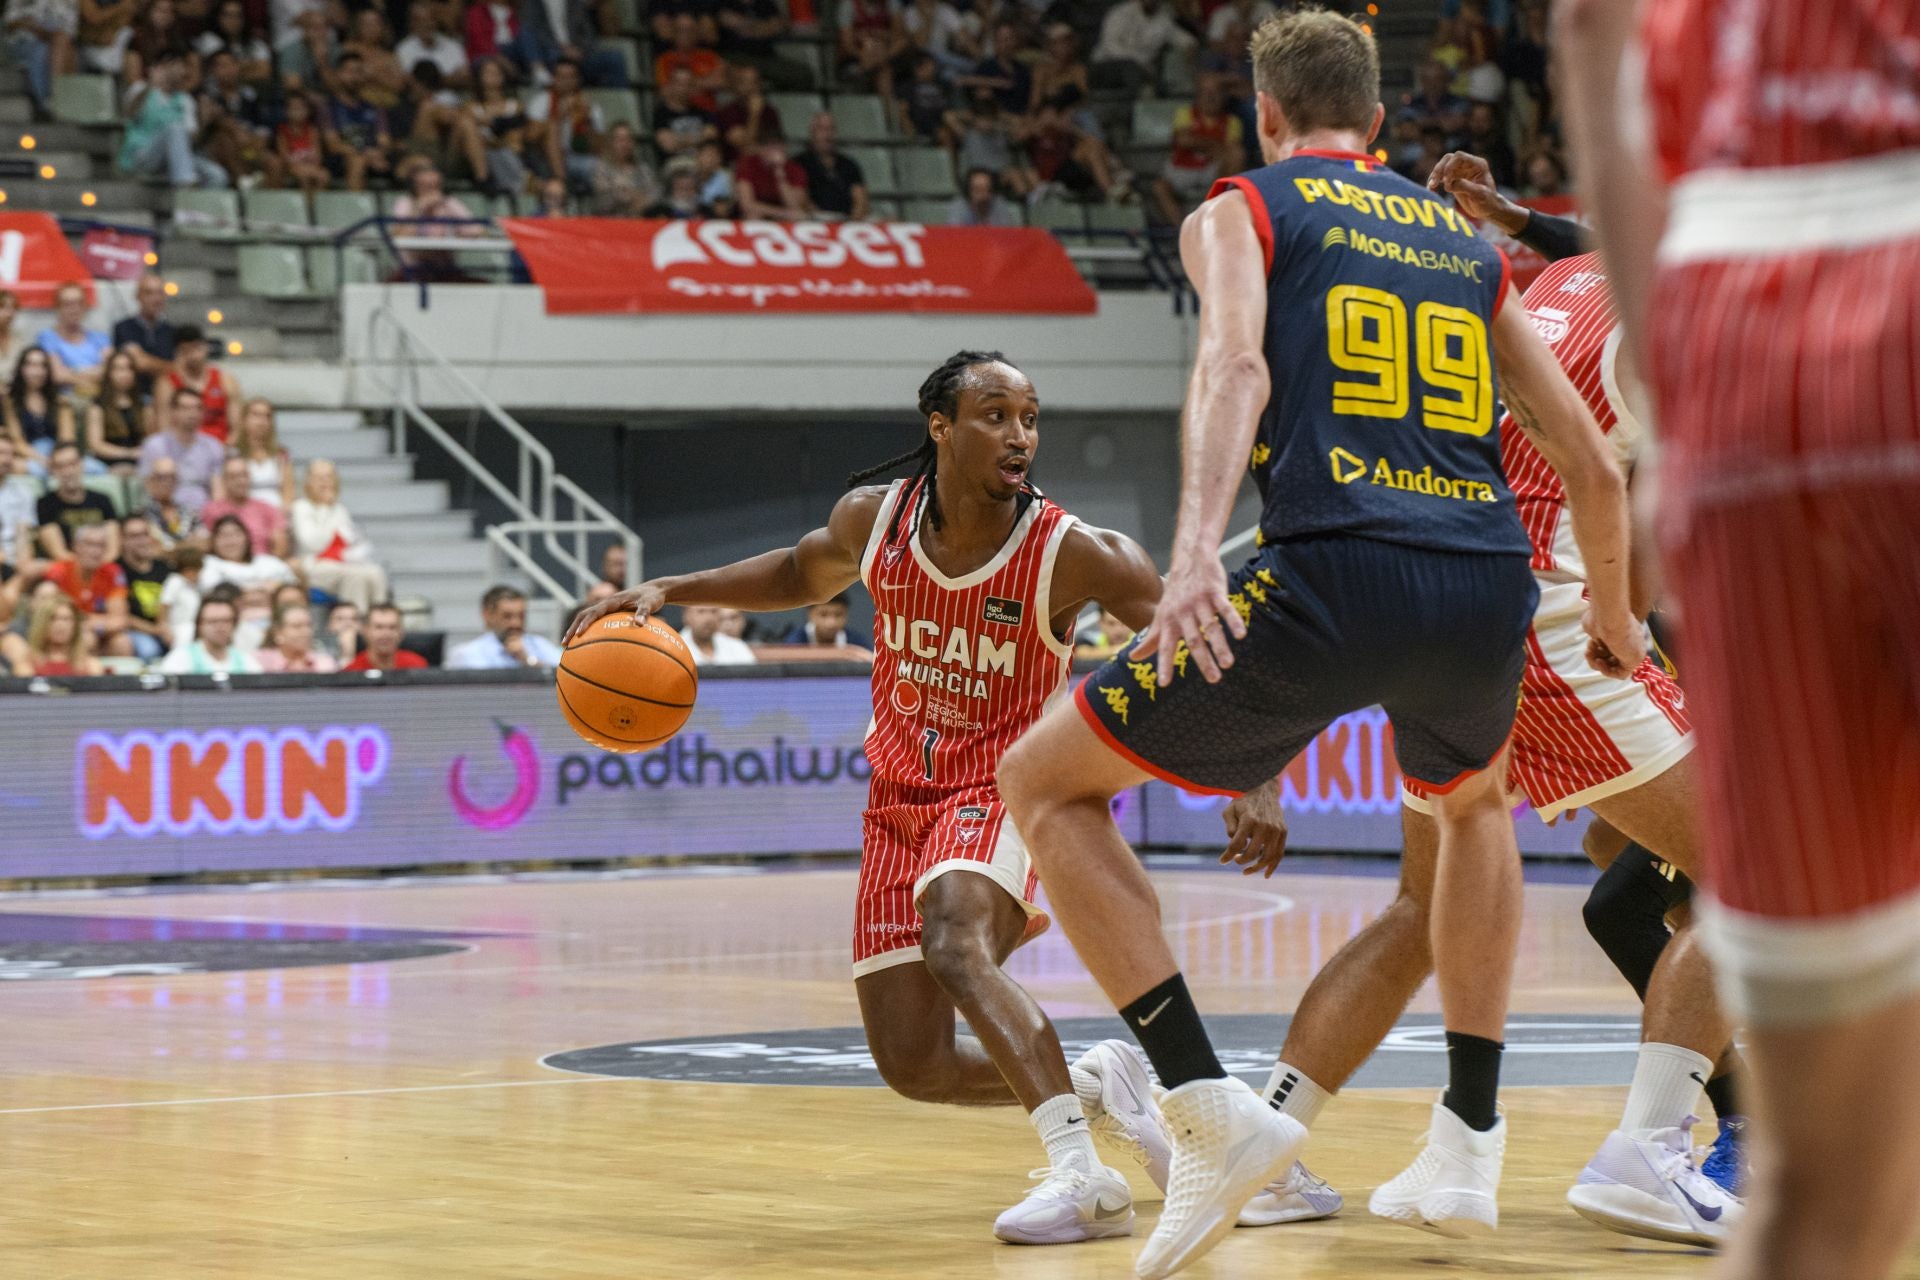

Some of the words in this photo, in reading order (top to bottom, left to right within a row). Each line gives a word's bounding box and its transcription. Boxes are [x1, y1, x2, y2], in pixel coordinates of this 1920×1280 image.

[1294, 178, 1474, 238] PUSTOVYI
[697, 219, 926, 268] caser
[1350, 228, 1482, 284] MORABANC
[1326, 284, 1493, 437] 99
[1371, 457, 1498, 502] Andorra
[881, 612, 1018, 678] UCAM
[898, 659, 988, 700] MURCIA
[927, 710, 939, 722] DE
[941, 716, 984, 730] MURCIA
[923, 727, 940, 781] 1
